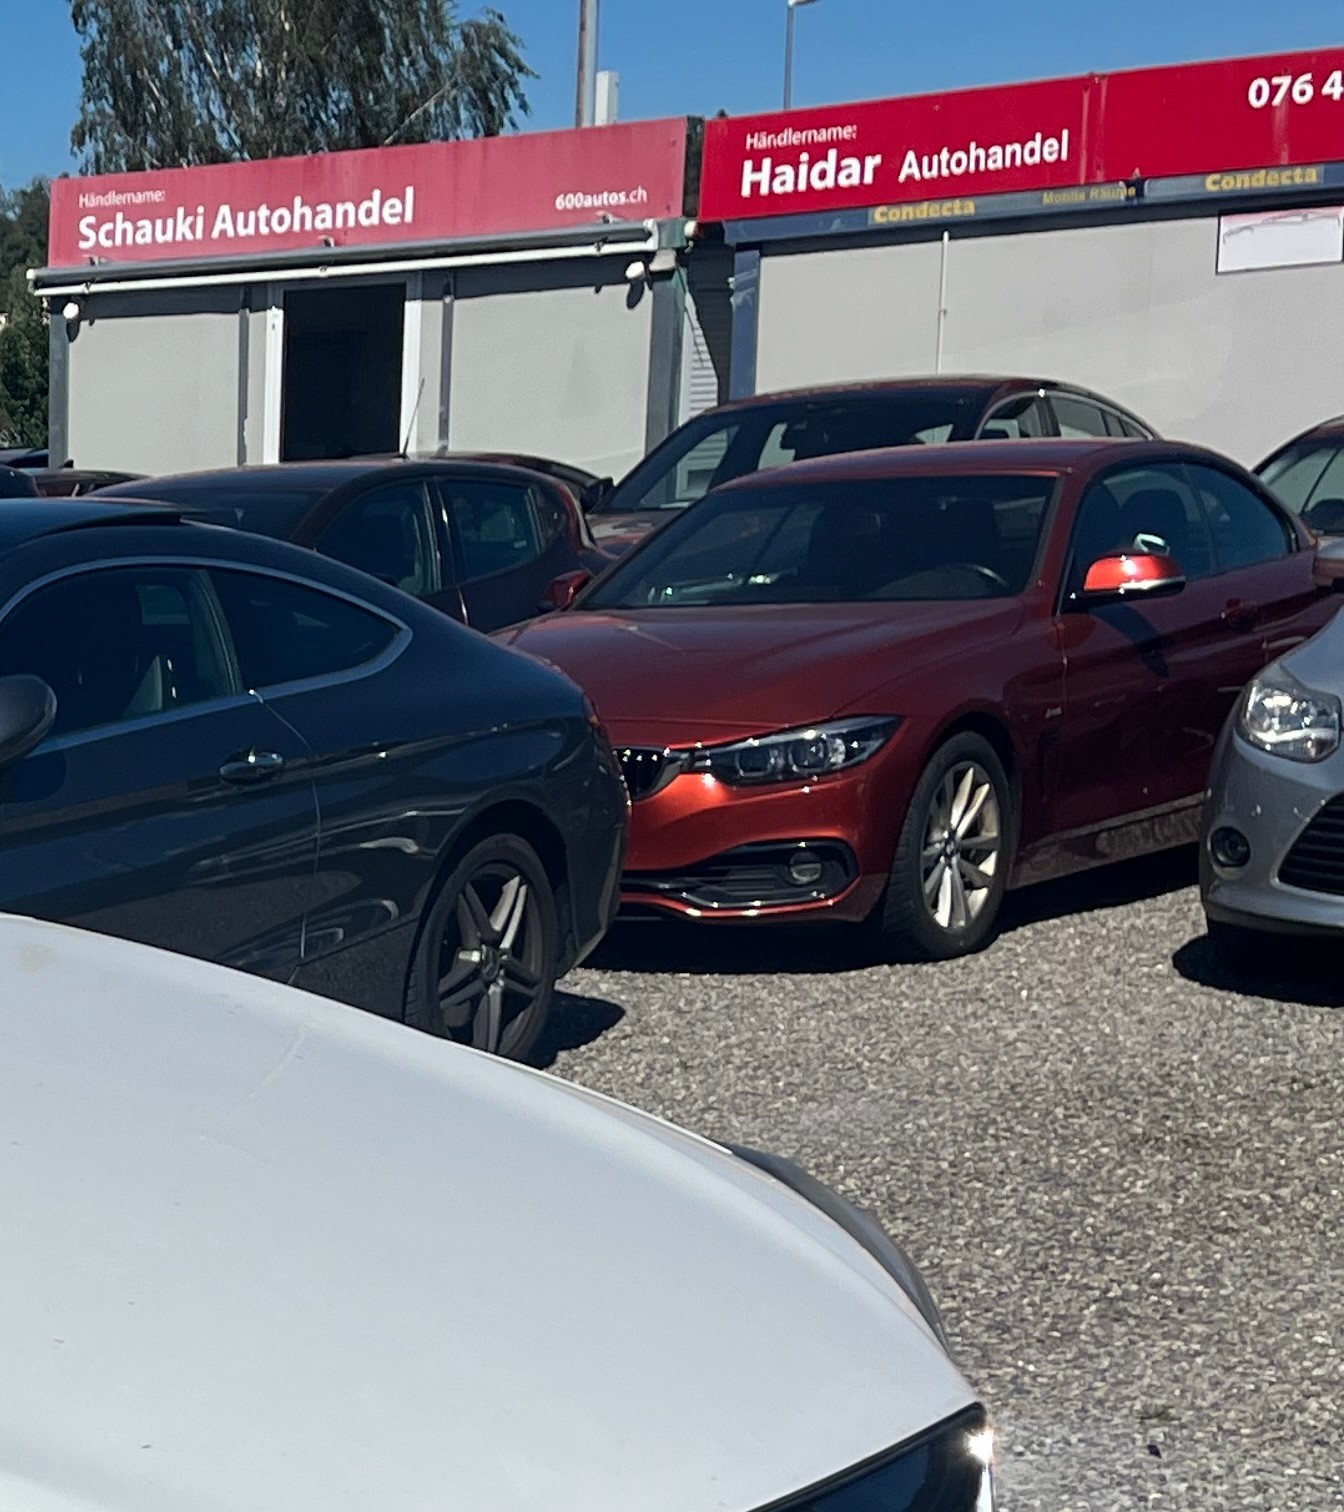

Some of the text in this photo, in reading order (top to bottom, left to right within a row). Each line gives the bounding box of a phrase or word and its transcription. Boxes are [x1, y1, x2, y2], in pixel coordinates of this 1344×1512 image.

[1247, 72, 1315, 110] 076
[745, 122, 858, 151] Händlername:
[740, 127, 1070, 199] Haidar Autohandel
[1205, 165, 1318, 192] Condecta
[78, 188, 166, 208] Händlername:
[554, 185, 649, 213] 600autos.ch
[873, 199, 976, 225] Condecta
[78, 185, 415, 249] Schauki Autohandel
